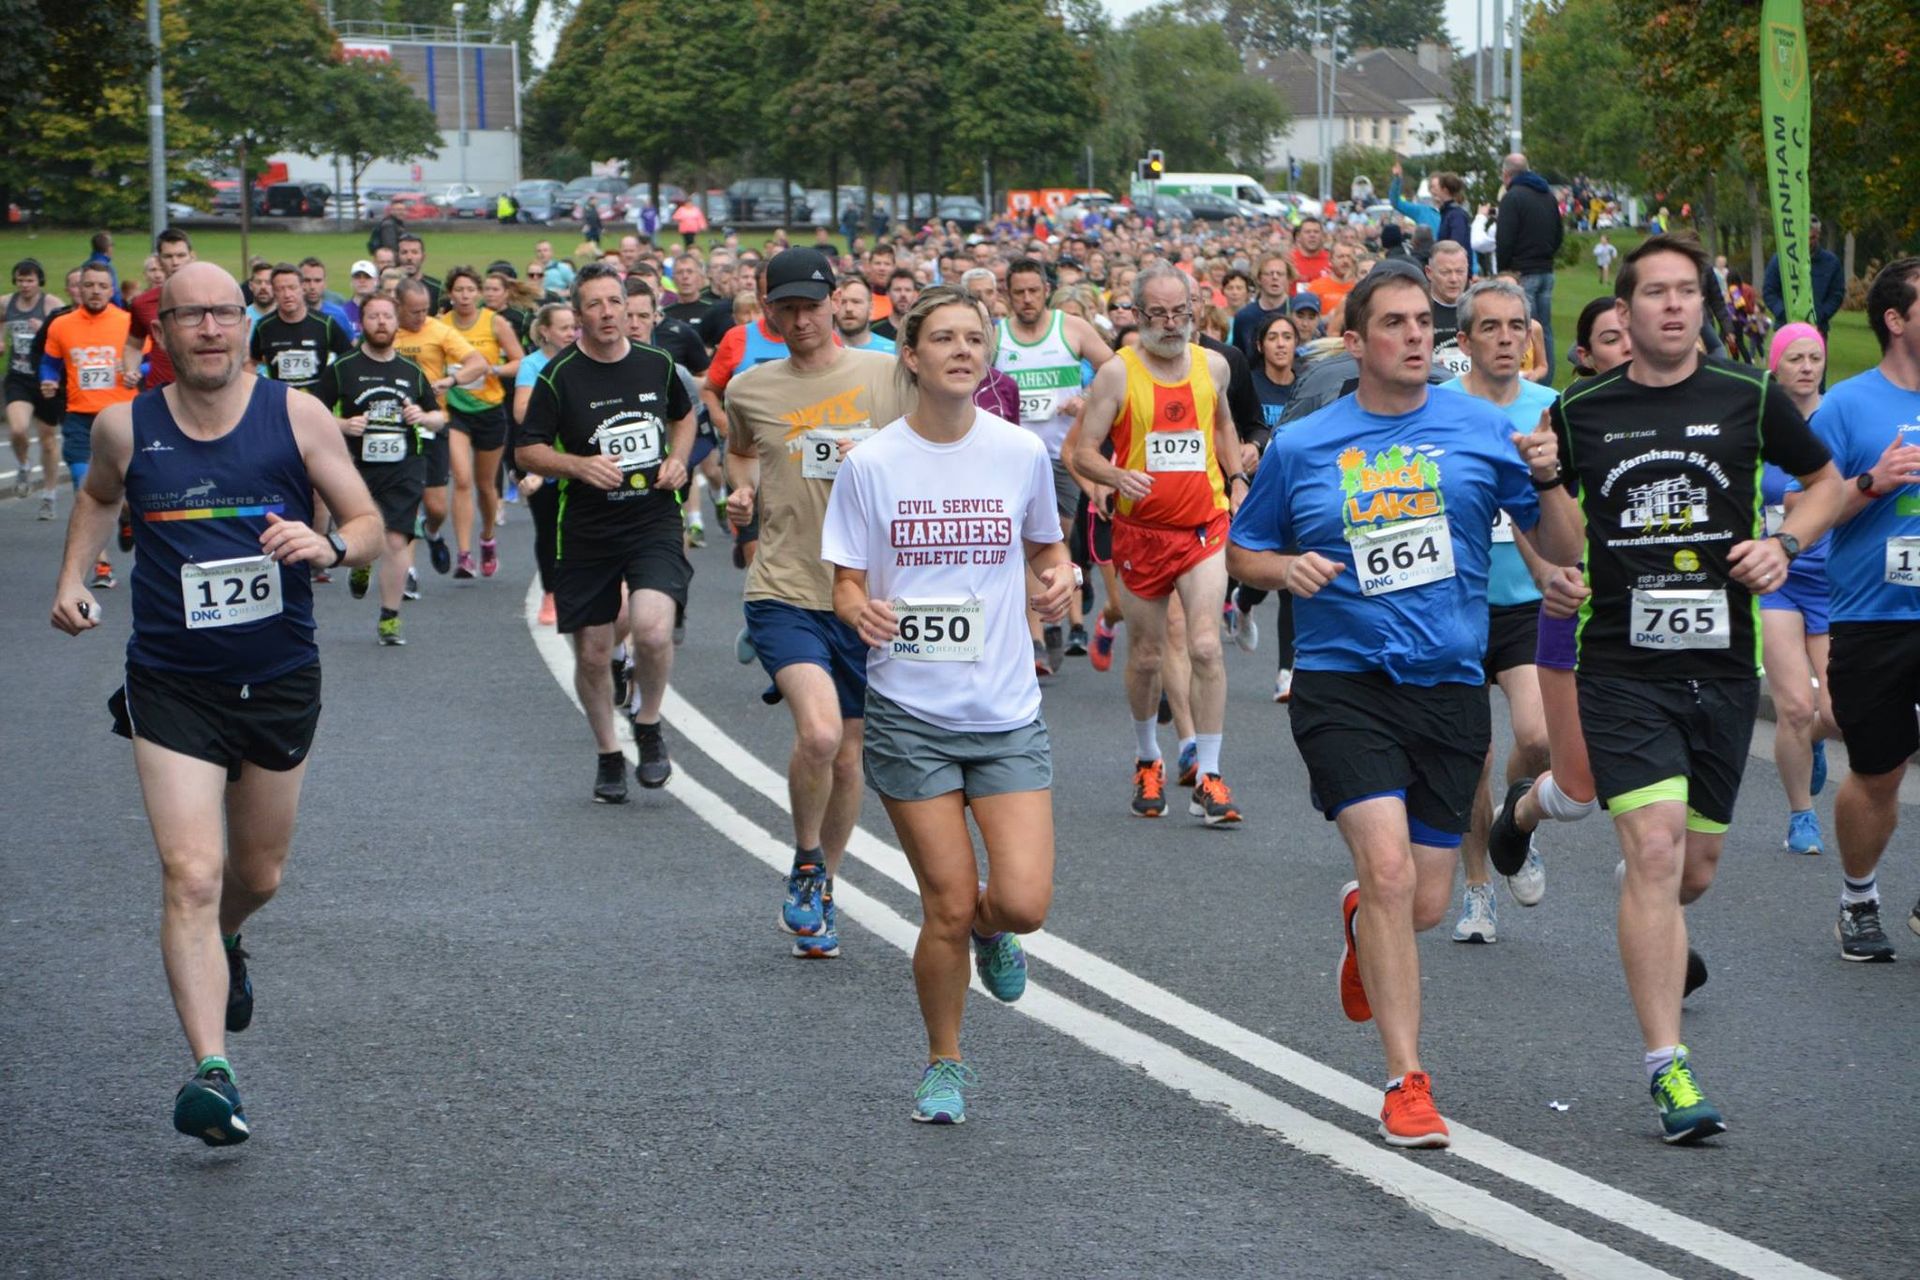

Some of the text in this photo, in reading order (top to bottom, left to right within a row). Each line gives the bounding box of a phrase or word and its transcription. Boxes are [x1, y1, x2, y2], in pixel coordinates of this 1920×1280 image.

[282, 358, 310, 369] 876
[82, 371, 110, 383] 872
[1685, 424, 1721, 437] DNG
[368, 441, 400, 454] 636
[609, 433, 652, 456] 601
[815, 442, 842, 463] 9
[1152, 439, 1201, 454] 1079
[1600, 449, 1685, 497] Rathfarnham
[1707, 461, 1731, 490] Run
[185, 495, 255, 508] RUNNERS
[898, 499, 1004, 514] CIVIL SERVICE
[1348, 490, 1441, 523] LAKE
[894, 519, 1011, 547] HARRIERS
[896, 550, 1007, 566] ATHLETIC CLUB
[1367, 536, 1440, 576] 664
[1898, 550, 1920, 571] 1
[198, 573, 270, 608] 126
[1364, 574, 1394, 591] DNG
[191, 610, 221, 622] DNG
[1644, 607, 1715, 634] 765
[899, 615, 970, 643] 650
[1636, 632, 1665, 643] DNG
[894, 642, 920, 654] DNG
